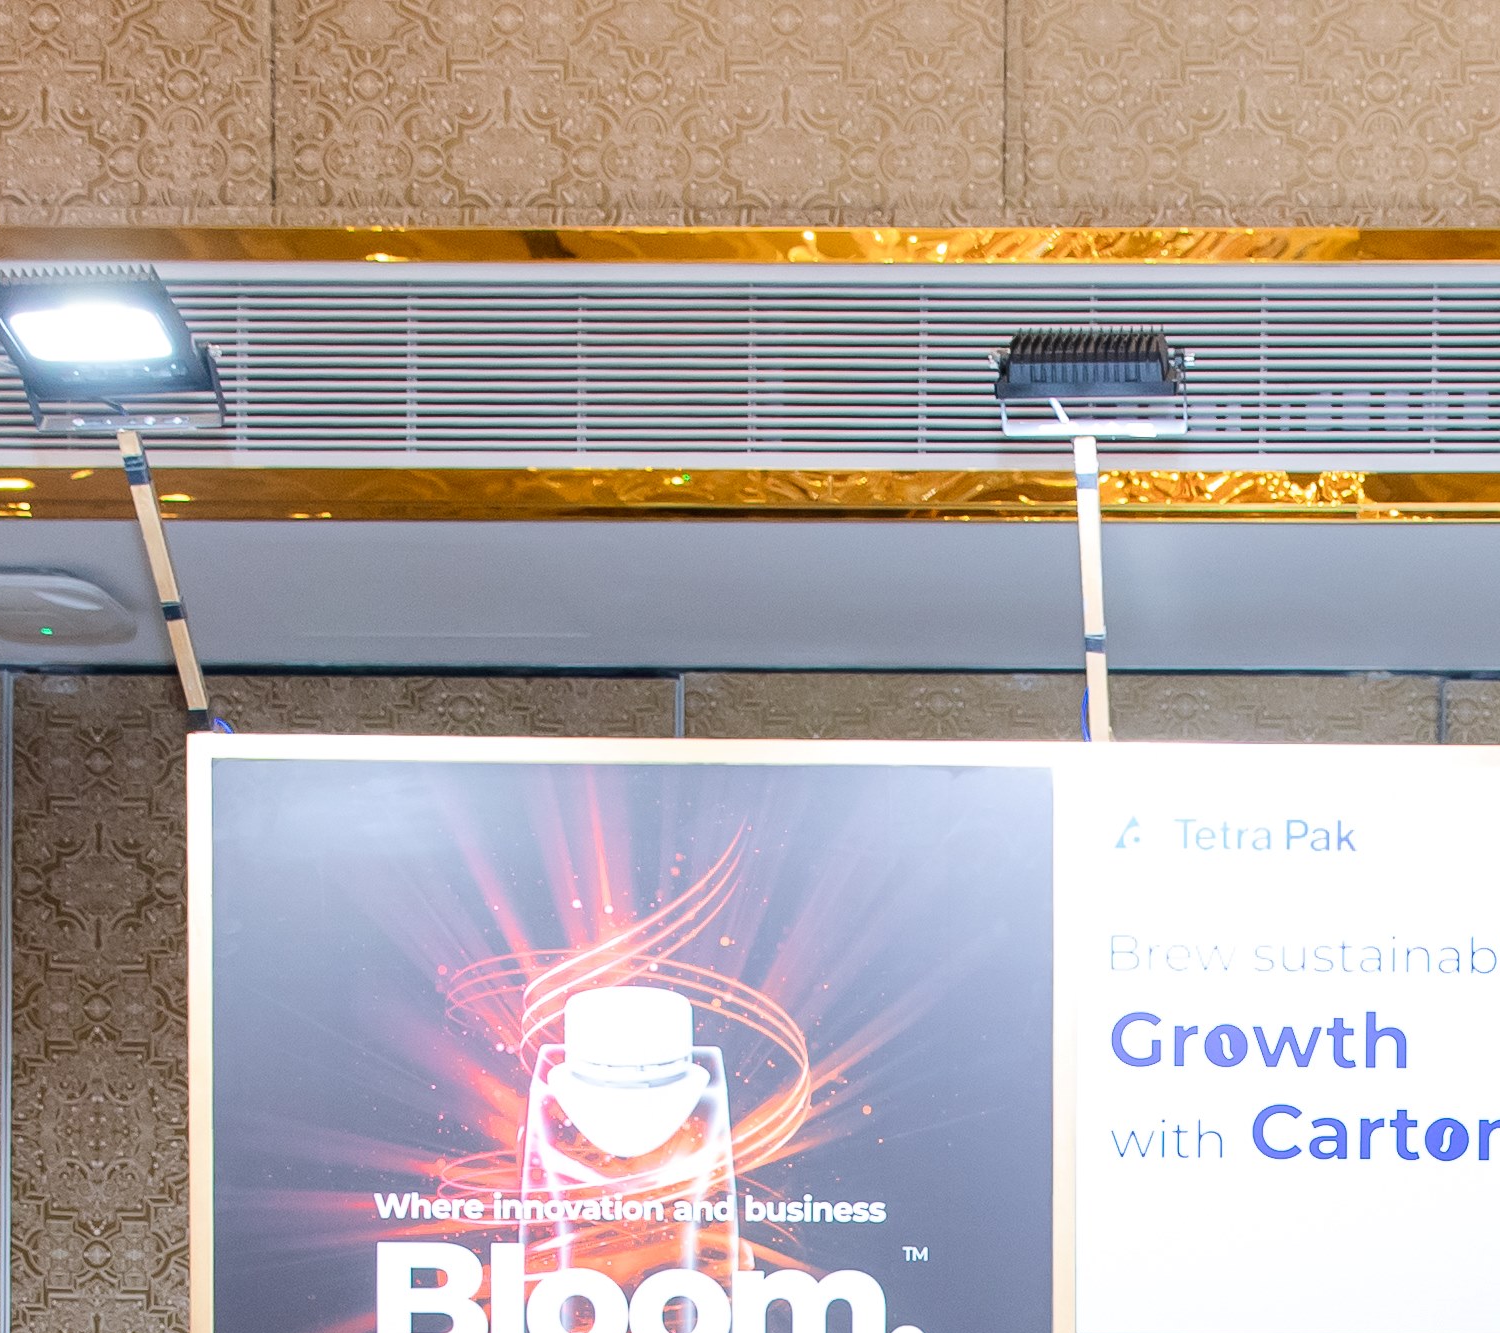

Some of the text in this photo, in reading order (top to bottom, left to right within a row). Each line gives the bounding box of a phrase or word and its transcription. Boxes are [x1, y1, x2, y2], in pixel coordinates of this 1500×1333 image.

[1174, 818, 1357, 852] Tetra Pak
[1110, 934, 1236, 972] Brew
[1111, 1010, 1408, 1069] Growth
[1110, 1119, 1224, 1159] with
[374, 1192, 887, 1224] Where innovation and business
